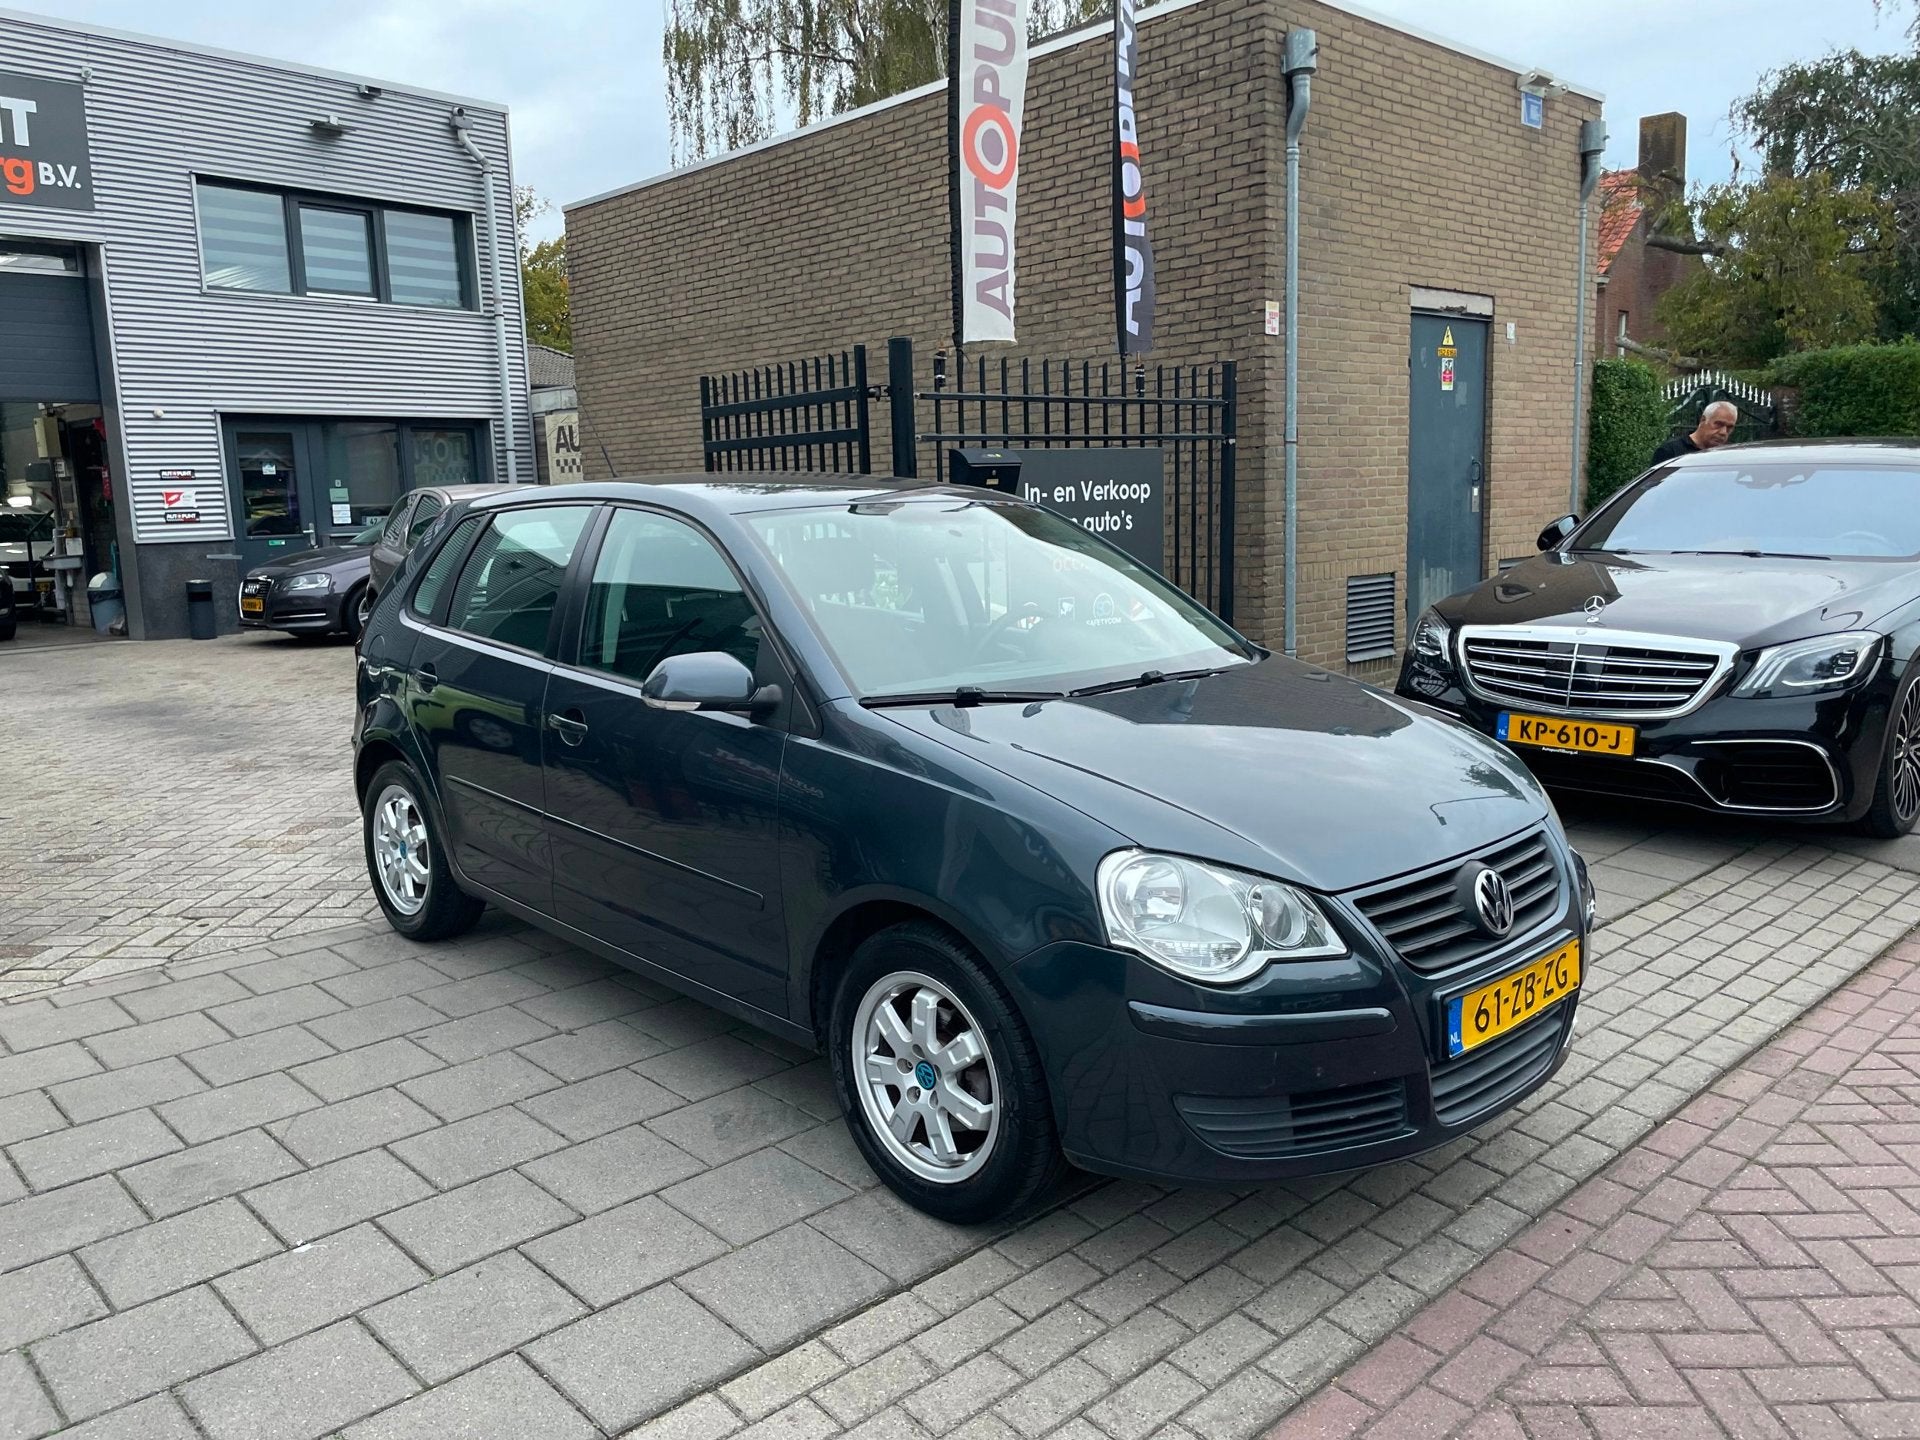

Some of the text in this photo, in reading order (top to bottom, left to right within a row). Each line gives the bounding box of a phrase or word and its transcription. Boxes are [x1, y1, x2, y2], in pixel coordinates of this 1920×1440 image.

[38, 161, 82, 189] B.V.
[1024, 479, 1151, 503] In- en Verkoop
[1083, 509, 1133, 532] auto's
[1519, 719, 1621, 750] KP-610-J
[1474, 952, 1568, 1033] 61-ZB-ZG
[1450, 1033, 1461, 1045] NL
